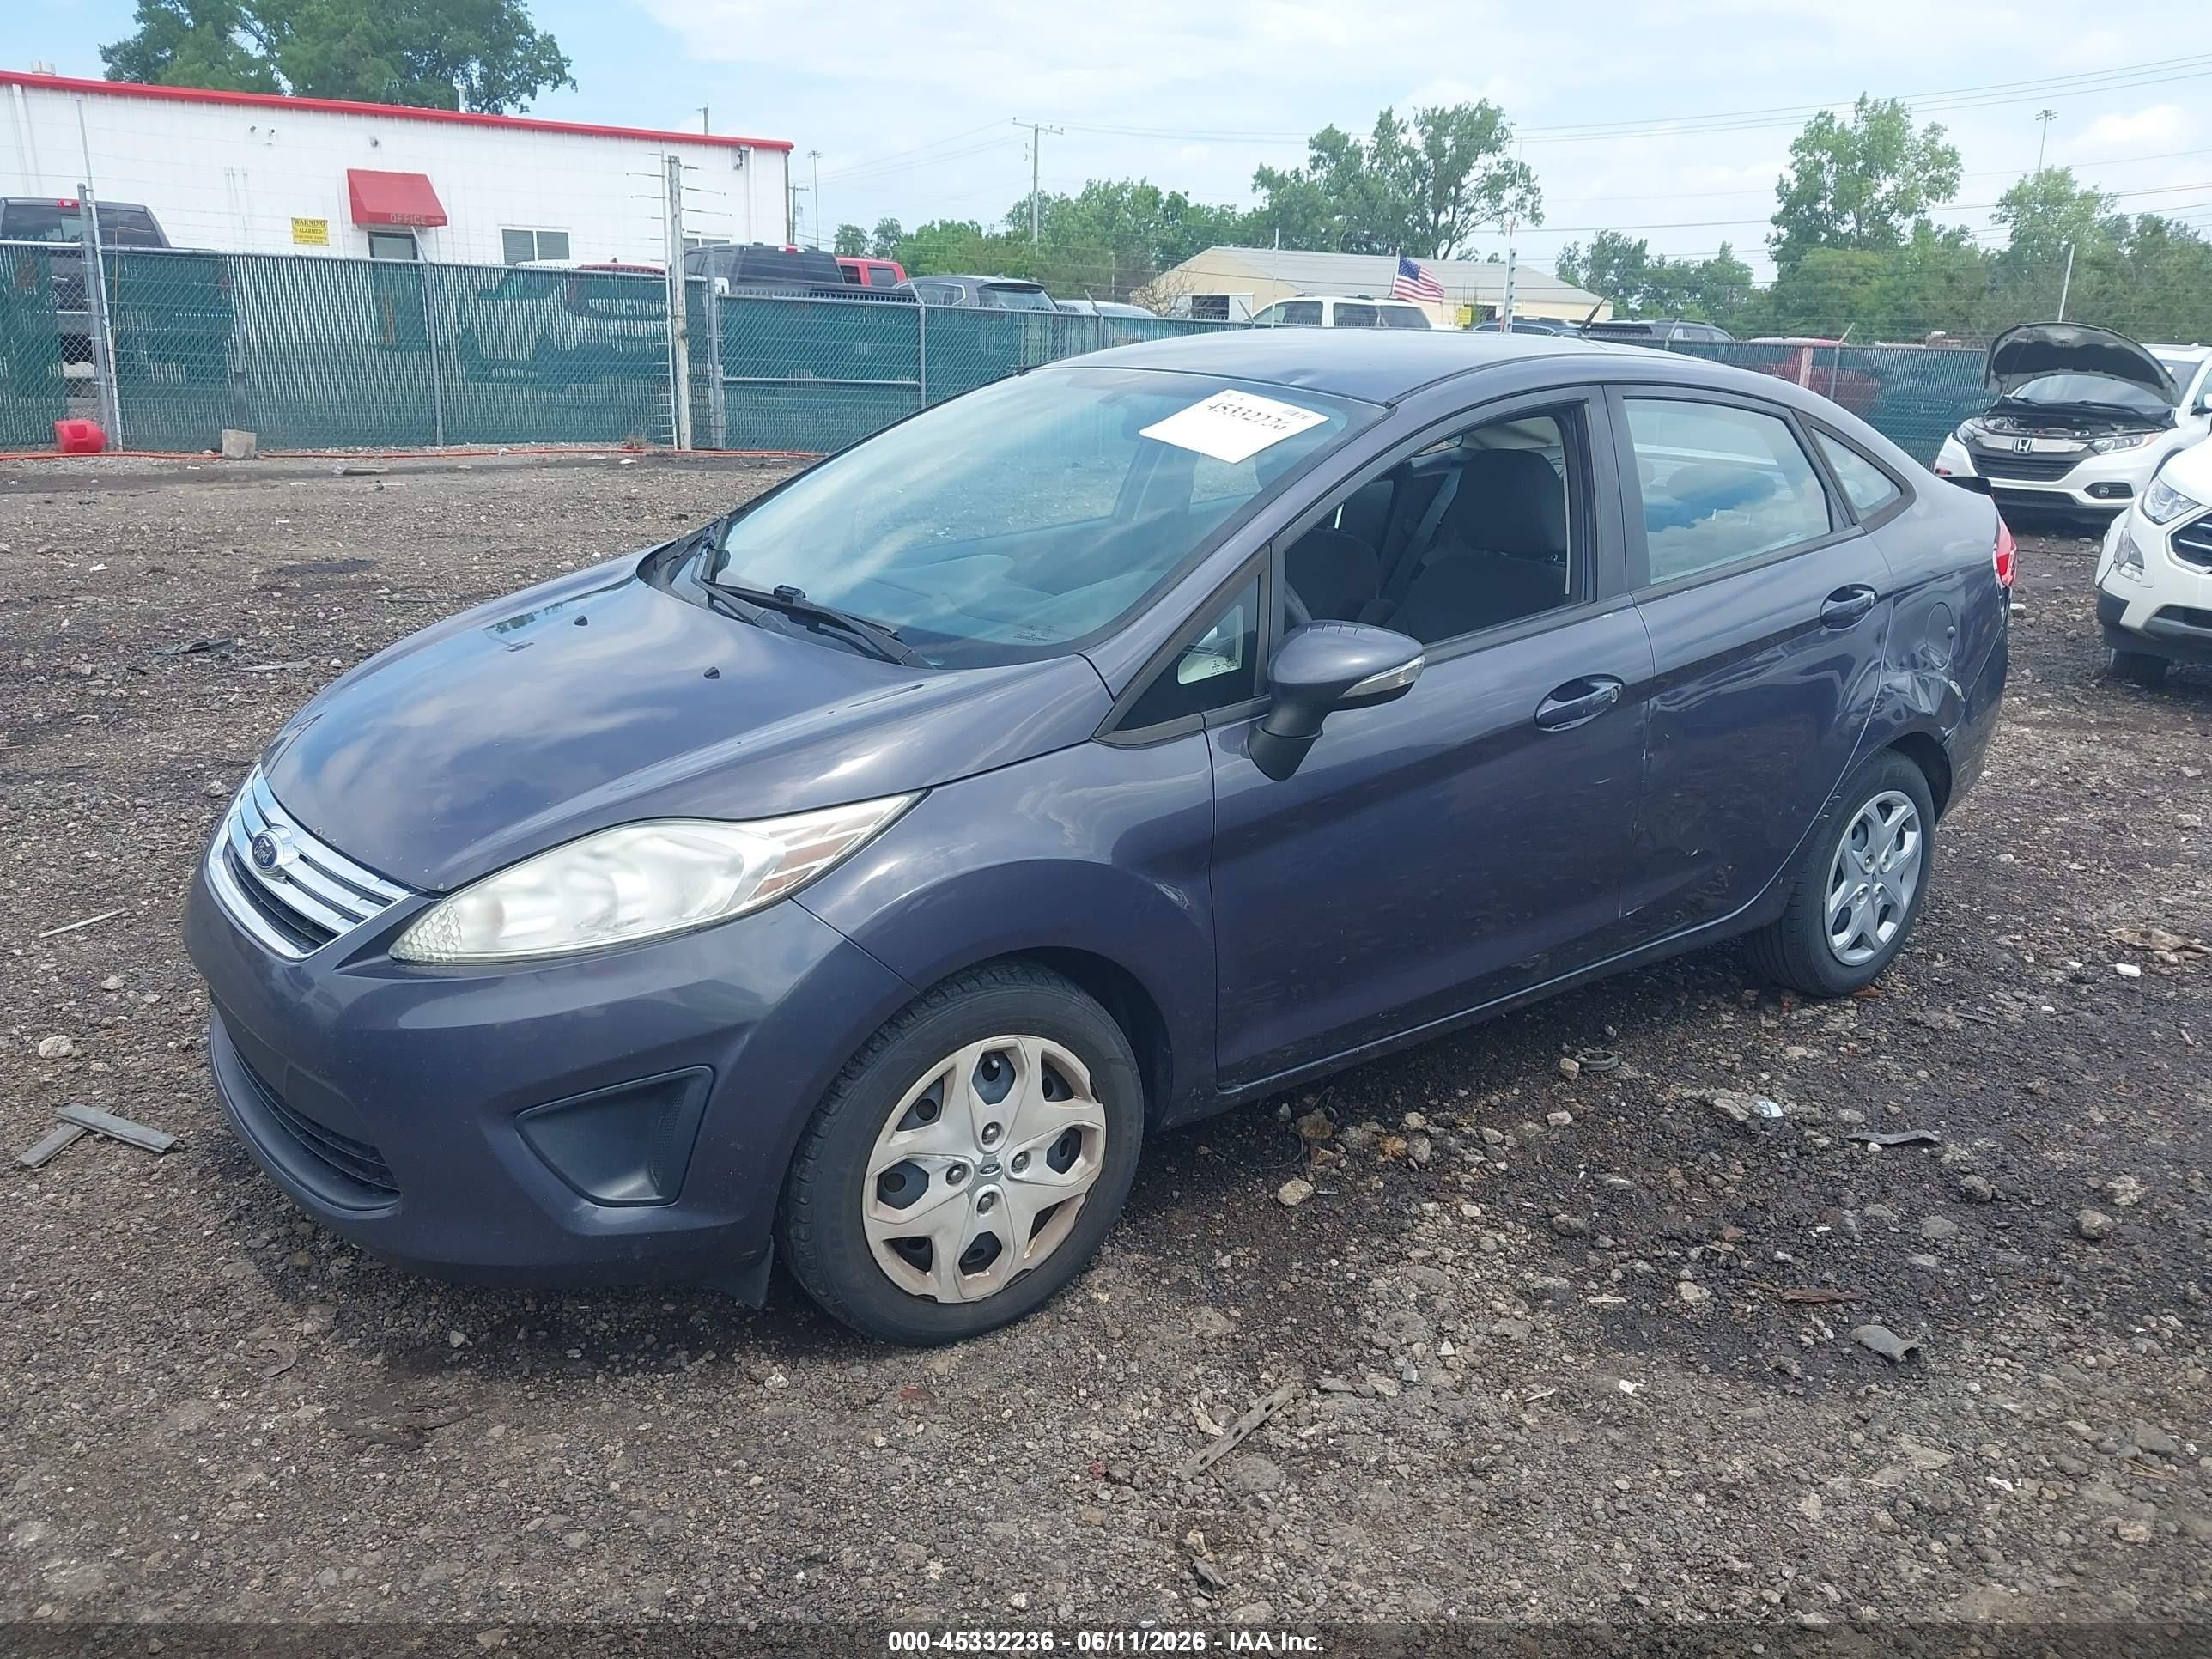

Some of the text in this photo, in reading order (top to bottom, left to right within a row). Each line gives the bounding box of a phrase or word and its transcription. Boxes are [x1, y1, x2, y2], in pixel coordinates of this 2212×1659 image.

[295, 220, 326, 228] WARNING
[390, 213, 427, 225] OFFICE
[253, 837, 274, 864] Ford
